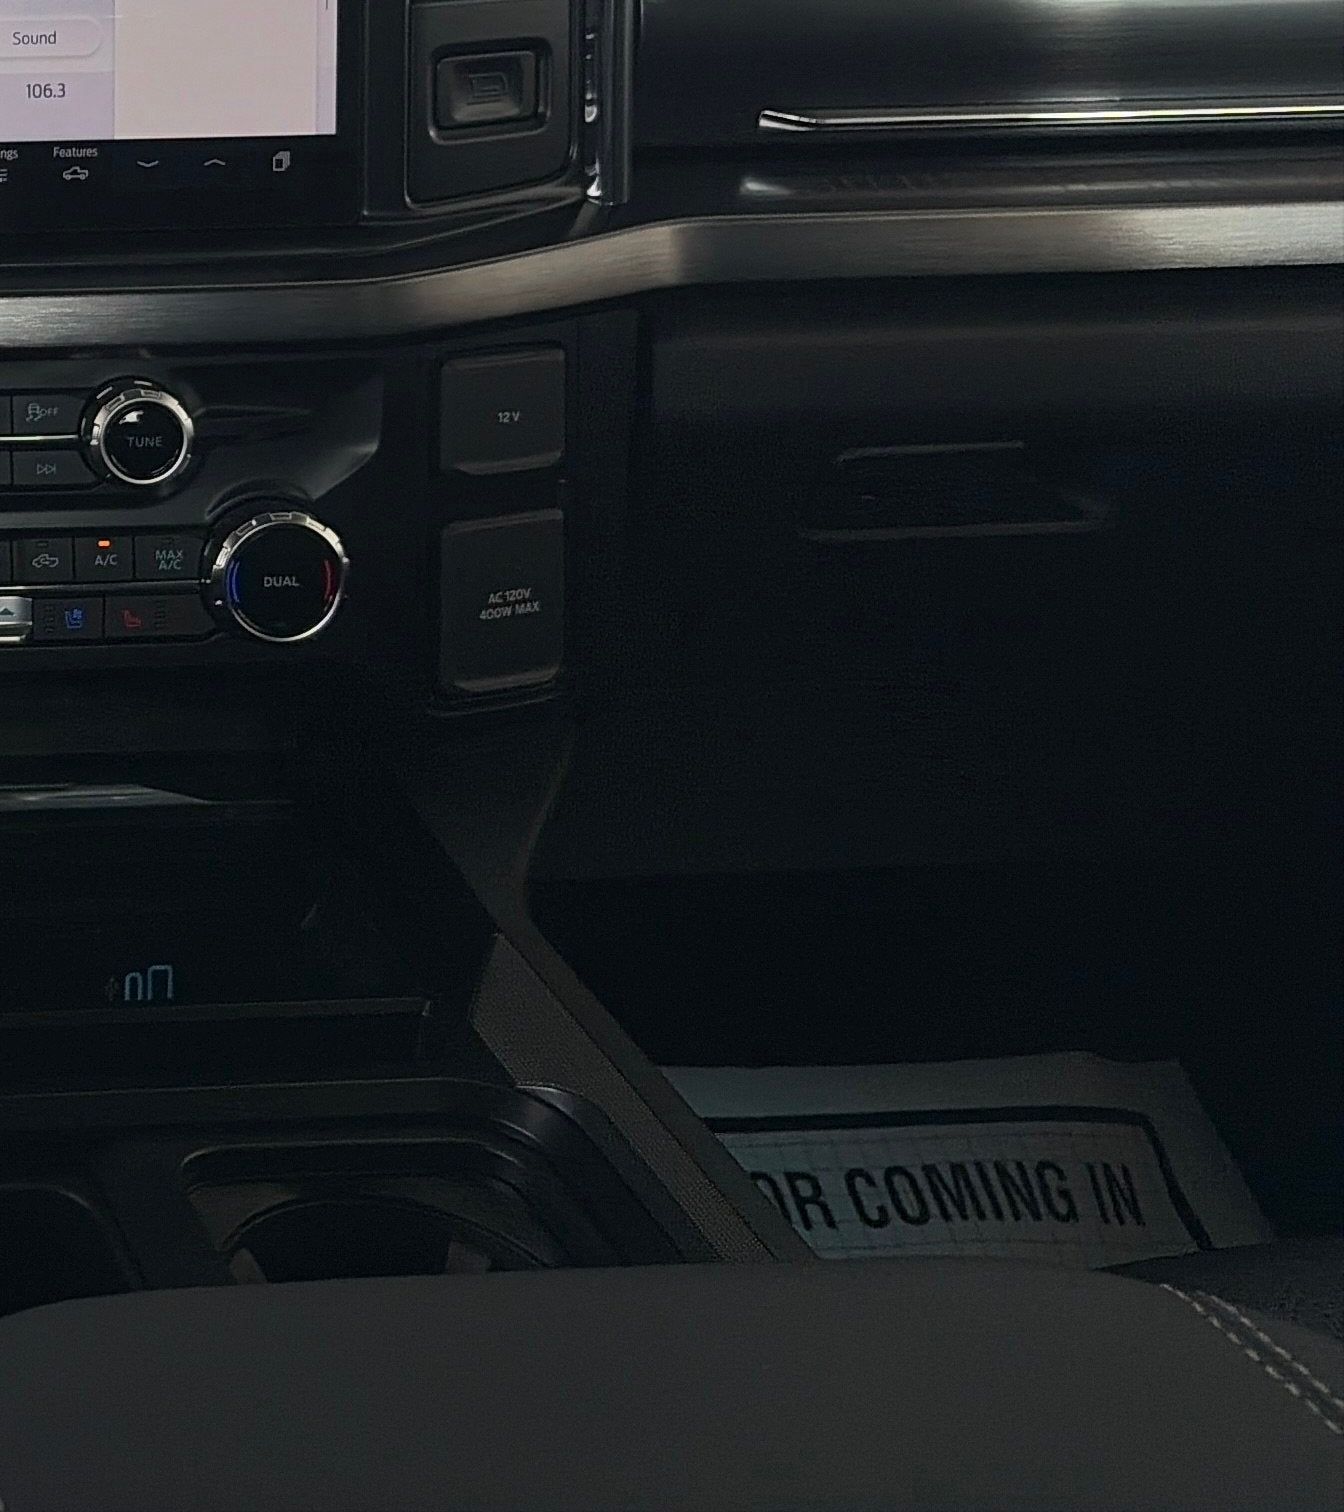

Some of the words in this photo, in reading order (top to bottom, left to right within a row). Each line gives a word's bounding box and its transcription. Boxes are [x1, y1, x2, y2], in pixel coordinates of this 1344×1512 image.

[12, 30, 57, 46] Sound
[25, 83, 67, 99] 106.3
[52, 146, 99, 159] Features
[41, 406, 59, 417] OFF
[127, 436, 163, 448] TUNE
[94, 553, 118, 567] A/C
[155, 549, 184, 560] MAX
[158, 559, 182, 571] A/C
[263, 575, 300, 588] DUAL
[514, 600, 540, 615] MAX
[843, 1158, 1080, 1229] COMING
[1086, 1160, 1146, 1227] IN
